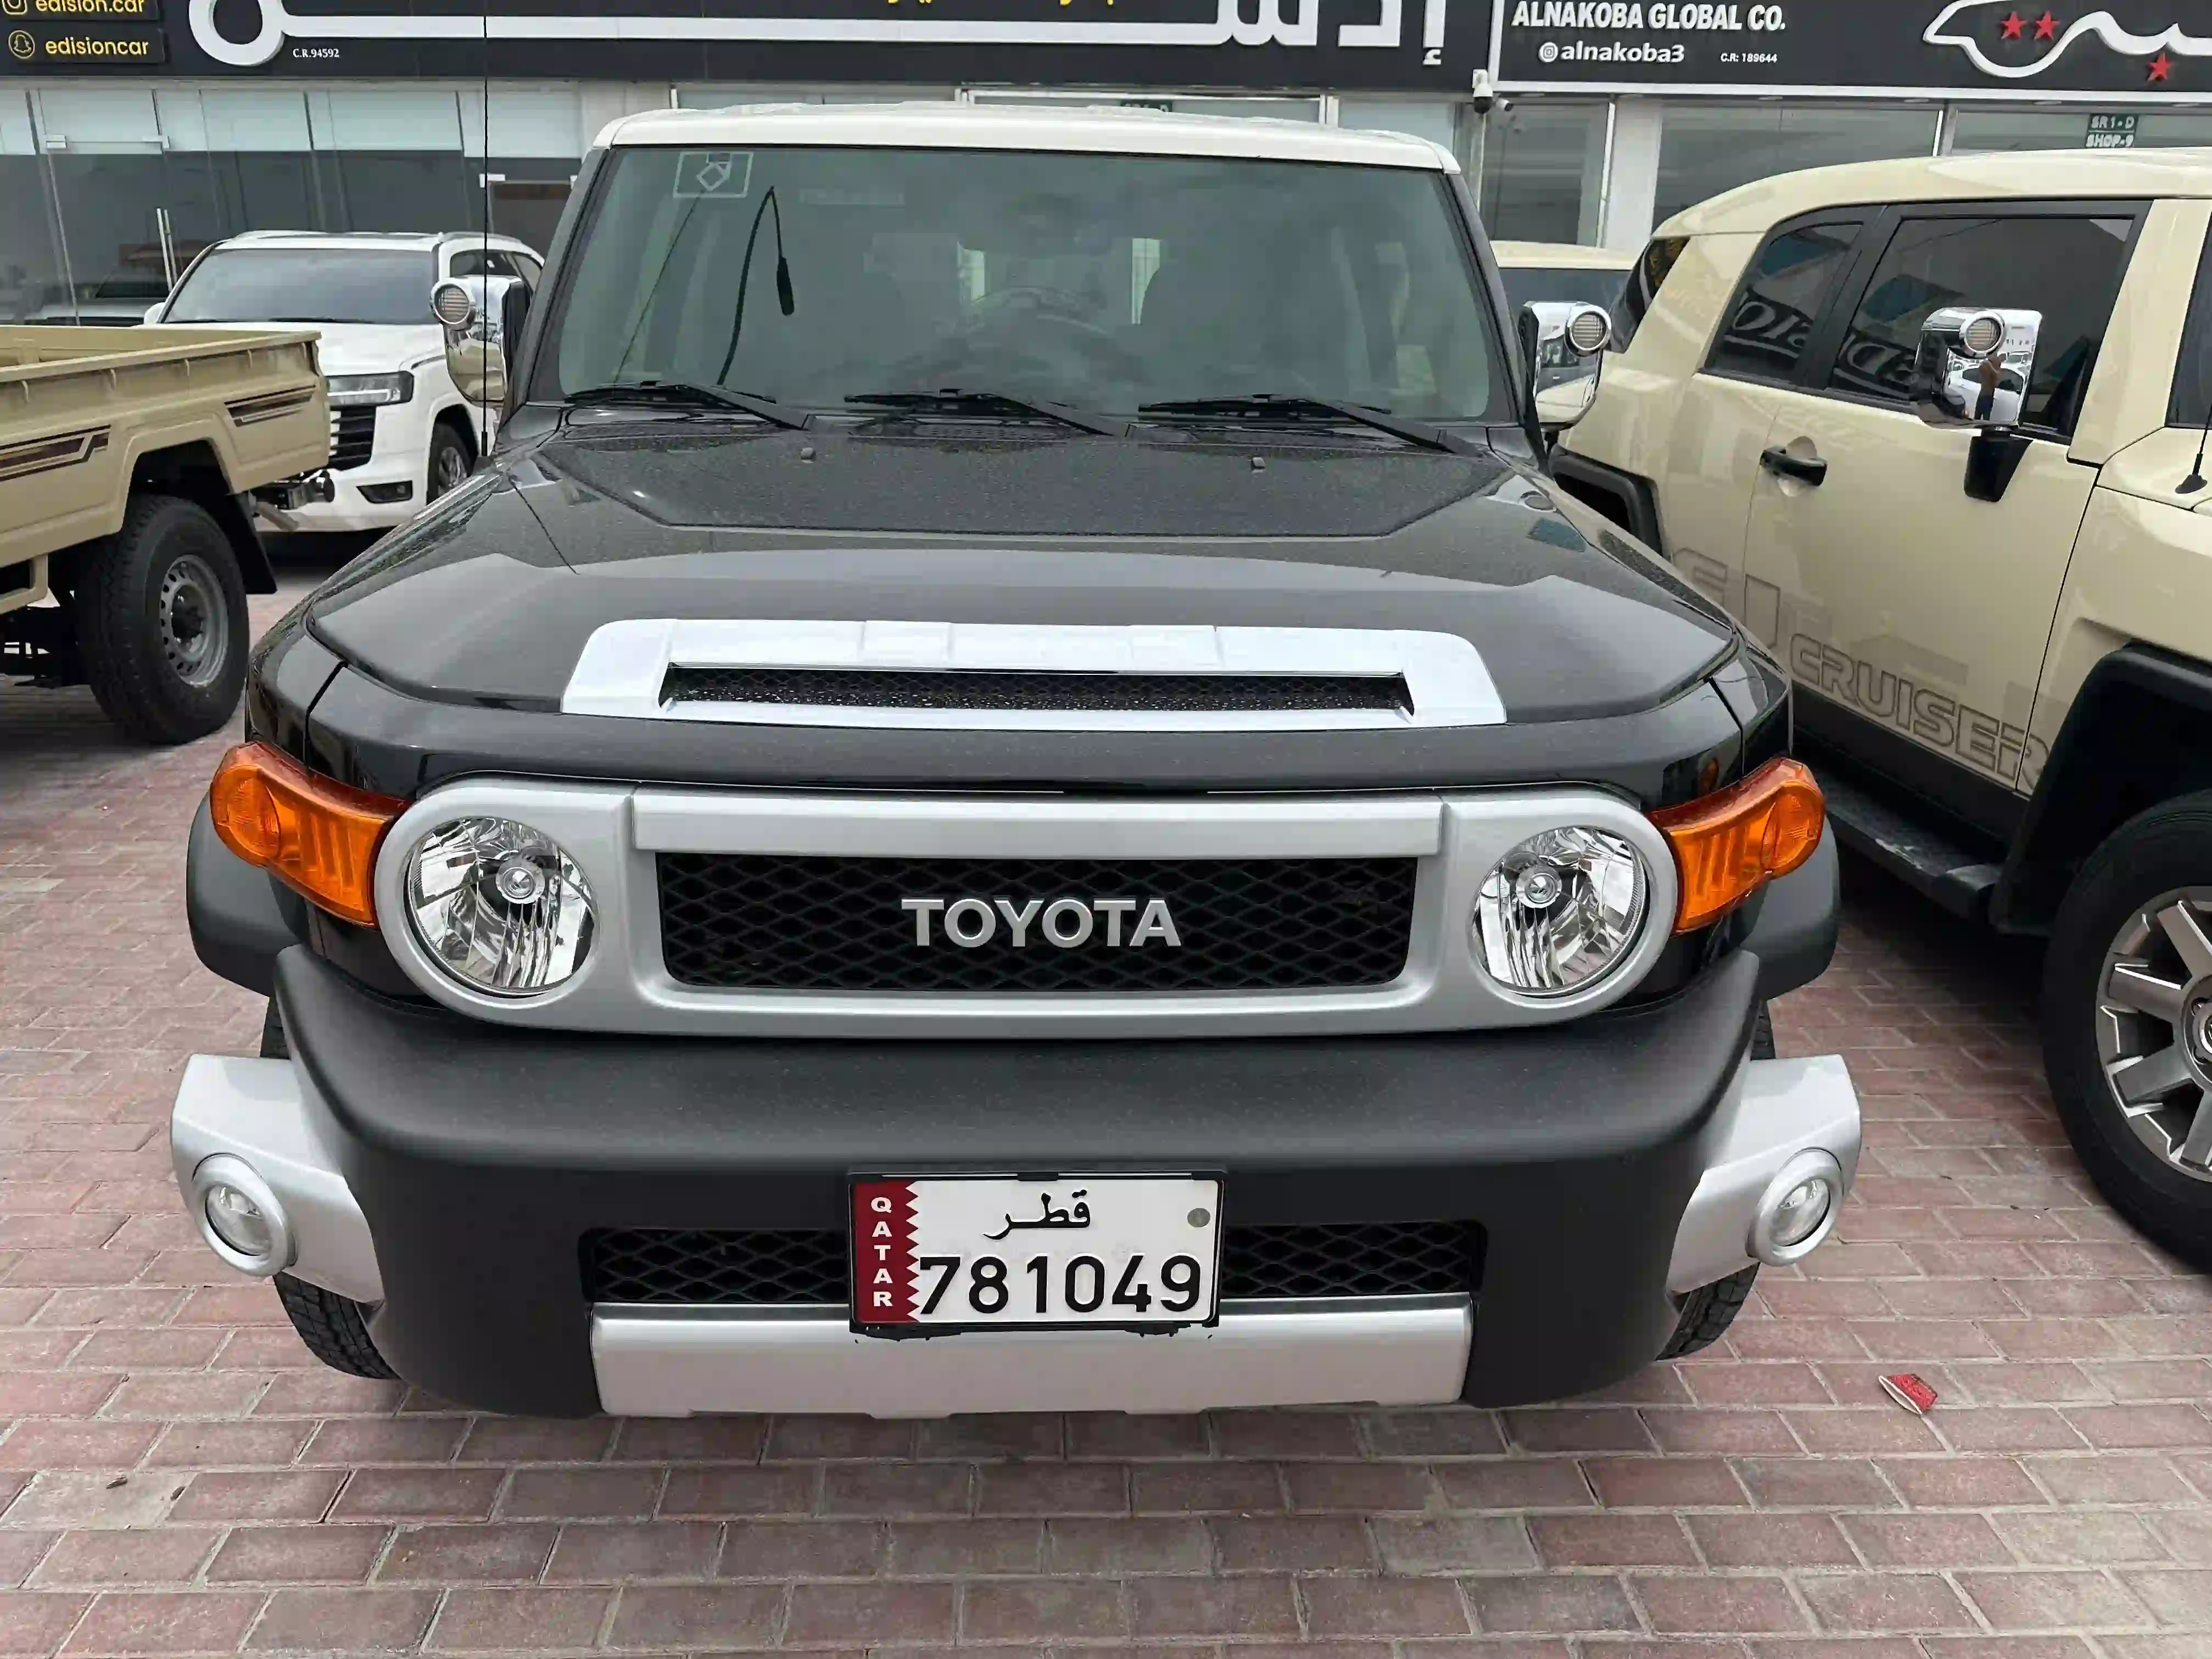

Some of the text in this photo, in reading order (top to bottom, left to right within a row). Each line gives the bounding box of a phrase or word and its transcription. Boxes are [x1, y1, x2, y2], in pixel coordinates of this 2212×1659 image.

[35, 0, 145, 13] edision.car
[1511, 1, 1786, 31] ALNAKOBA GLOBAL CO.
[45, 37, 149, 55] edisioncar
[1789, 633, 2050, 791] CRUISER
[901, 898, 1181, 948] TOYOTA
[982, 1188, 1091, 1240] قطر
[870, 1196, 893, 1308] QATAR
[919, 1253, 1202, 1314] 781049
